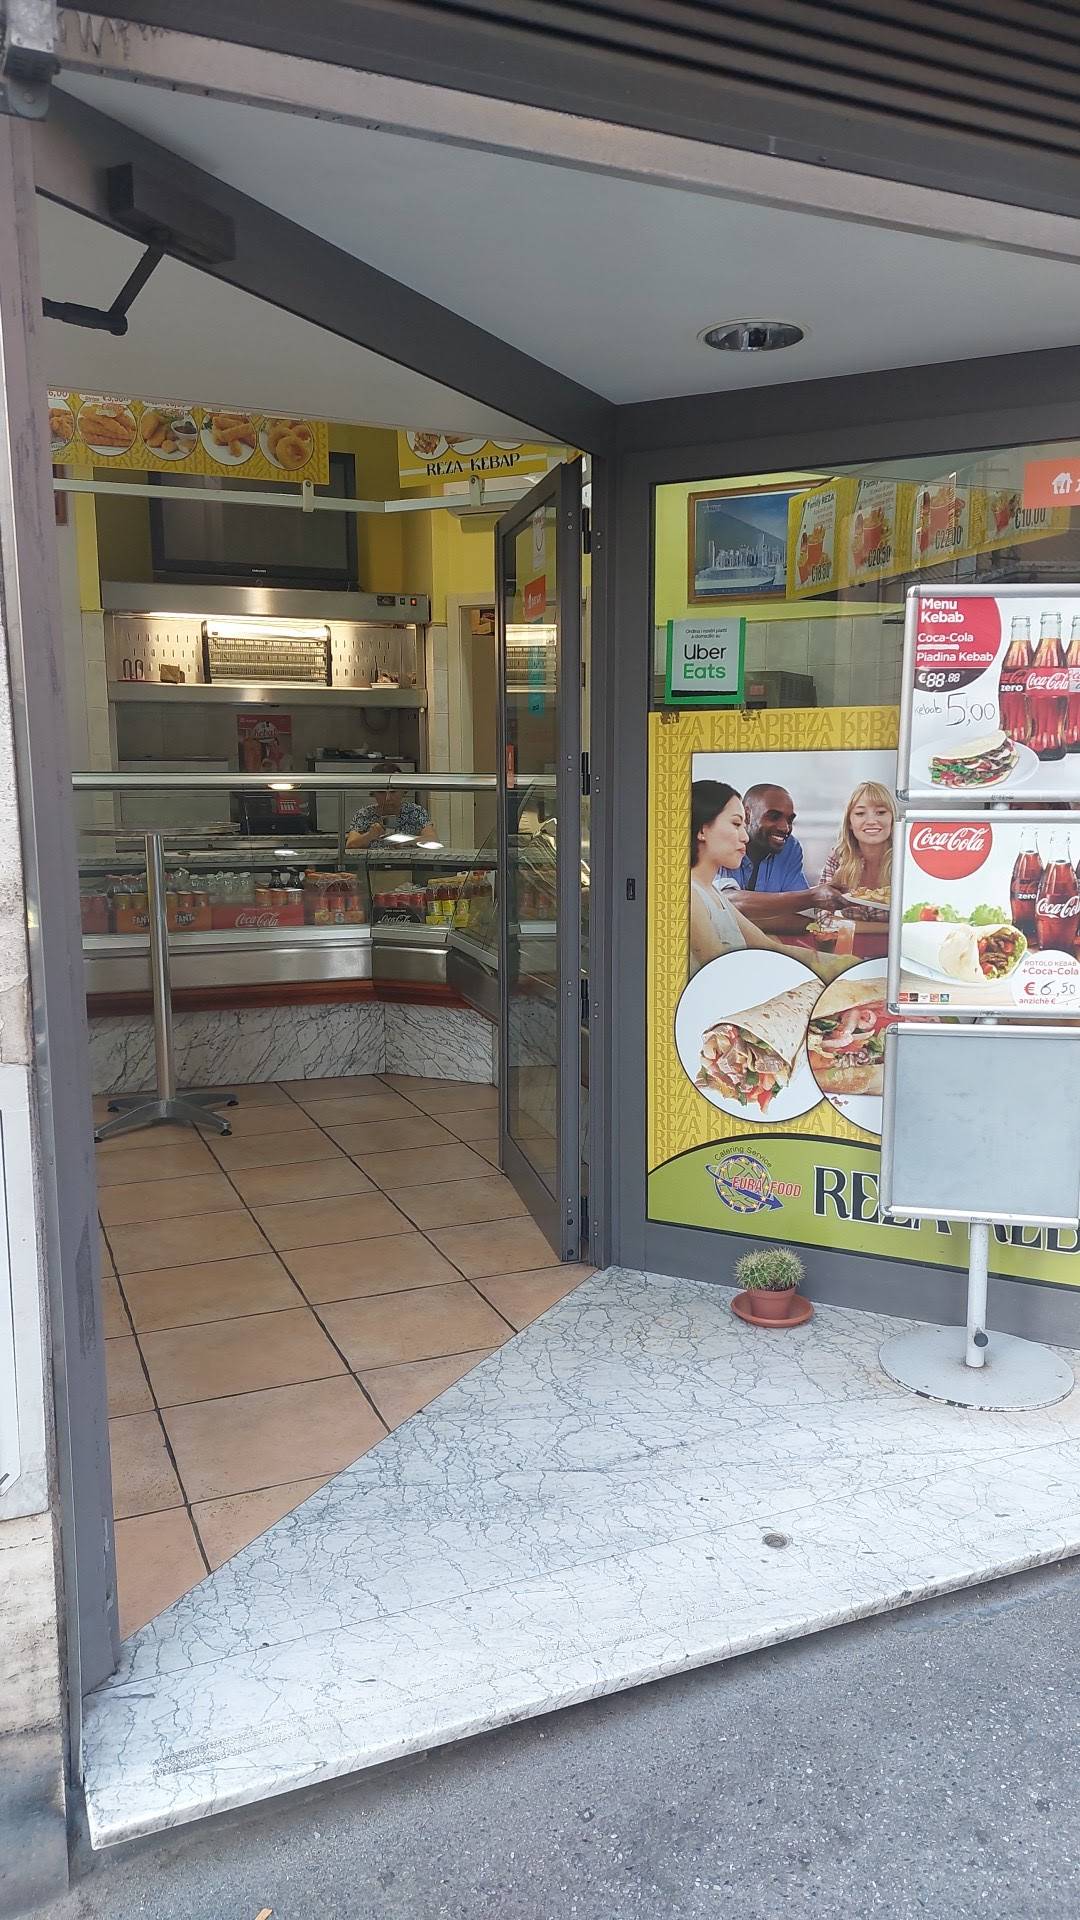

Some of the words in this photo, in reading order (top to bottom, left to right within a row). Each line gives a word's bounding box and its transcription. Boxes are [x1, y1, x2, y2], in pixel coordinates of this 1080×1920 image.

[427, 460, 463, 476] REZA
[470, 453, 520, 472] KEBAP
[821, 493, 834, 505] REZA
[921, 599, 957, 610] Menu
[920, 611, 965, 623] Kebab
[917, 632, 974, 642] Coca-Cola
[684, 644, 727, 660] Uber
[916, 652, 957, 662] Piadina
[958, 652, 994, 662] Kebab
[683, 663, 726, 679] Eats
[1000, 684, 1024, 692] zero
[1027, 672, 1069, 690] Coca-Cola
[946, 692, 996, 727] 5,00
[912, 827, 990, 851] Coca-Cola
[235, 912, 280, 928] Coca-Cola
[1023, 981, 1036, 996] €
[1040, 980, 1077, 998] 6,50
[714, 1146, 745, 1161] Catering
[746, 1146, 773, 1168] Service
[770, 1180, 802, 1197] FOOD
